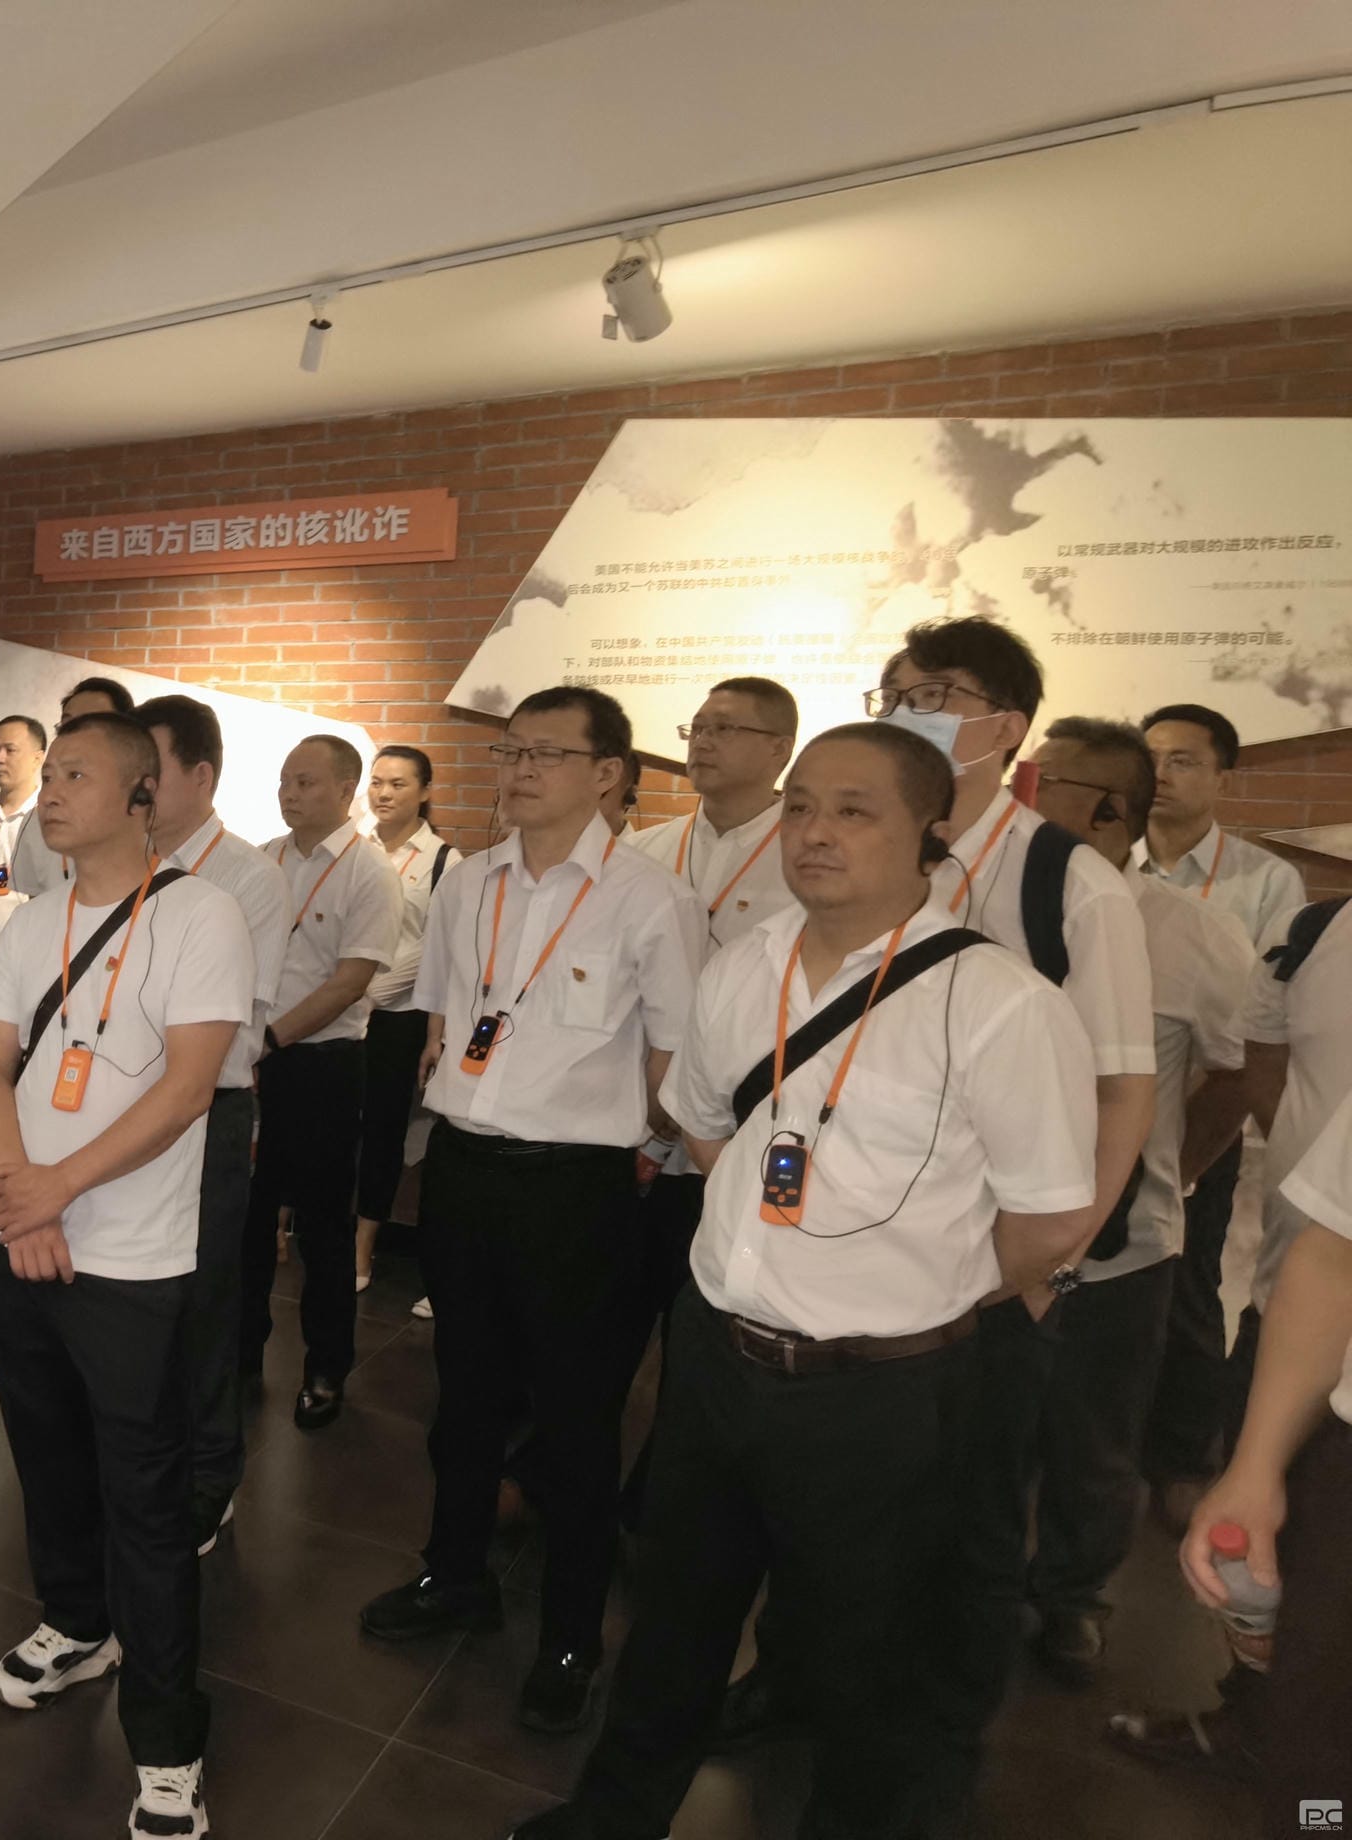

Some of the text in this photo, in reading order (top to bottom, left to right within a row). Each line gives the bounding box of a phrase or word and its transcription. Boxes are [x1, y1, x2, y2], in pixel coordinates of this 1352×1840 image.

[59, 505, 411, 561] 来自西方国家的核讹诈
[1051, 631, 1295, 646] 不排除在朝鲜使用原子弹的可能。
